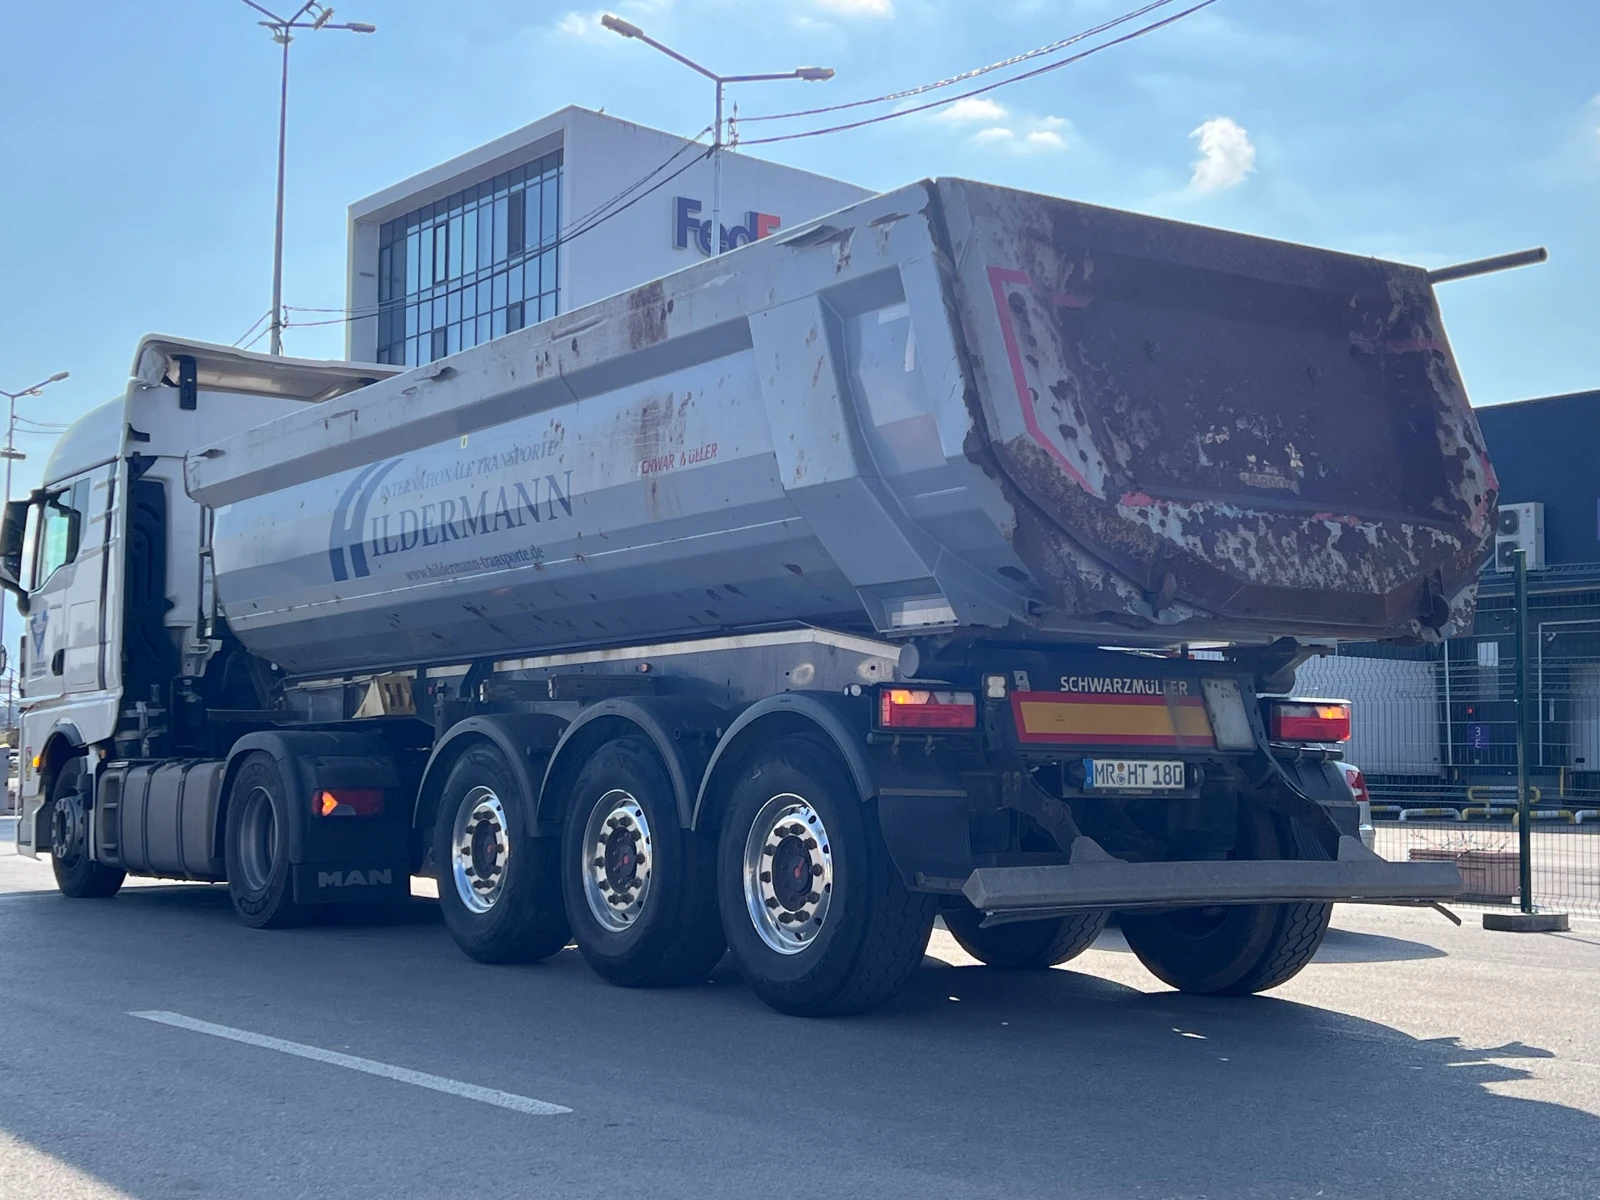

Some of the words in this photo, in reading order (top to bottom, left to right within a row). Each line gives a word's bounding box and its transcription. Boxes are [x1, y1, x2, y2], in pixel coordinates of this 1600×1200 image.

[476, 438, 559, 475] TRANSPORTE
[404, 544, 546, 581] www.hildermann-transporte.de
[1095, 763, 1116, 785] MR
[1127, 764, 1148, 785] HT
[1153, 764, 1183, 786] 180
[318, 868, 392, 888] MAN
